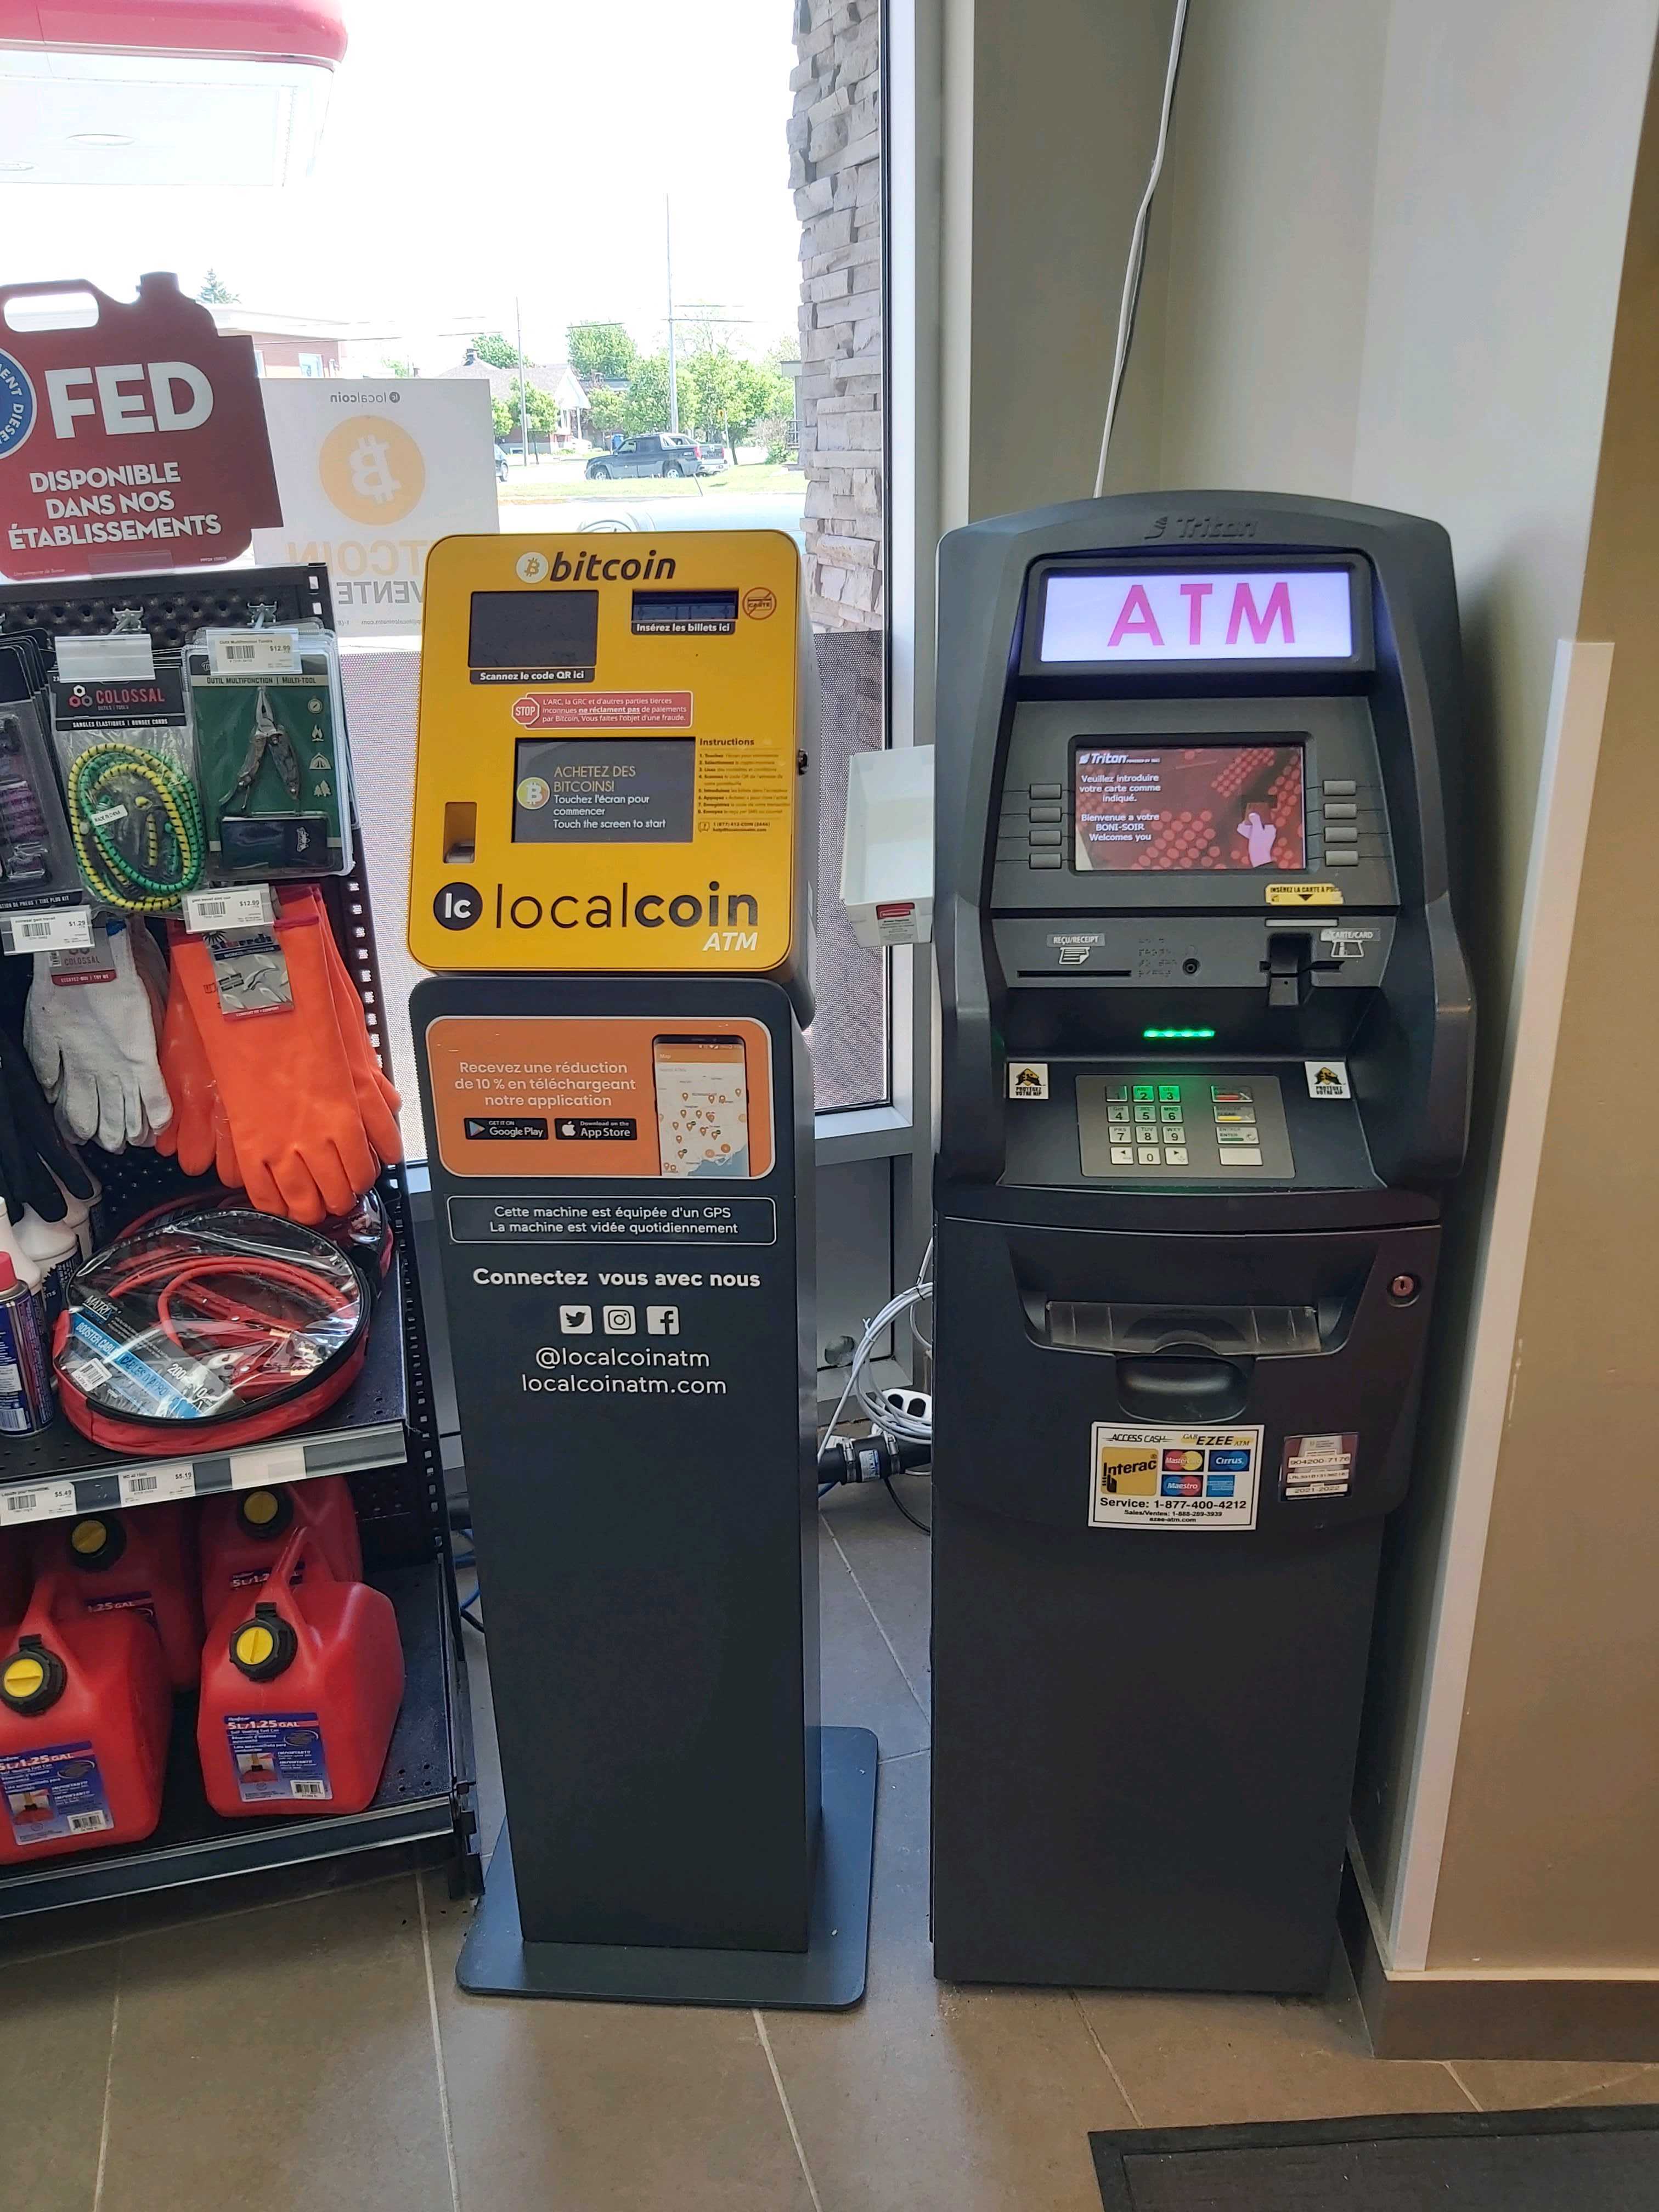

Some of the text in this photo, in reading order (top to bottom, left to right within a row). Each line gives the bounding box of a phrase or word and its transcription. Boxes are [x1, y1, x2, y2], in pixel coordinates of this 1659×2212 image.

[44, 362, 215, 439] FED
[29, 462, 181, 493] DISPONIBLE
[45, 490, 175, 520] DANS NOS
[8, 514, 222, 550] ÉTABLISSEMENTS
[550, 550, 676, 582] bitcoin
[1107, 582, 1295, 647] ATM
[636, 623, 730, 632] Insérez les billets ici
[480, 670, 584, 681] Scannez le code QR ici
[95, 687, 165, 704] COLOSSAL
[515, 706, 535, 716] STOP
[619, 715, 640, 723] l'objet
[1091, 753, 1128, 764] Triton
[554, 766, 636, 777] ACHETEZ DES
[554, 781, 615, 793] BITCOINS!
[554, 794, 650, 805] Touchez l'écran pour
[1102, 794, 1137, 803] indiqué.
[553, 808, 606, 816] commencer
[1081, 814, 1126, 822] Bienvenue
[553, 819, 666, 829] Touch the screen to start
[1089, 833, 1152, 842] Welcomes you
[496, 881, 759, 929] localcoin
[702, 932, 759, 951] ATM
[1053, 935, 1099, 945] REÇU/RECEIPT
[64, 956, 101, 966] COLOSSAL
[459, 1062, 628, 1074] Recevez une réduction
[455, 1078, 636, 1093] de 10 % en téléchargeant
[485, 1094, 612, 1109] notre application
[1139, 1092, 1148, 1101] 2
[1166, 1092, 1174, 1100] 3
[1115, 1112, 1123, 1120] 4
[1142, 1112, 1150, 1120] 5
[1168, 1112, 1176, 1120] 6
[489, 1126, 544, 1138] Google Play
[580, 1127, 631, 1139] App Store
[1117, 1132, 1125, 1141] 7
[1144, 1132, 1152, 1141] 8
[1171, 1133, 1178, 1141] 9
[1146, 1153, 1154, 1162] 0
[494, 1206, 731, 1221] Cette machine est équipée d'un GPS
[490, 1221, 738, 1235] La machine est vidée quotidiennement
[472, 1268, 761, 1287] Connectez vous avec nous
[75, 1322, 103, 1345] BOOSTER
[535, 1347, 710, 1369] @localcoinatm
[522, 1374, 727, 1395] localcoinatm.com
[1111, 1433, 1166, 1442] ACCESS CASH
[1195, 1436, 1234, 1446] EZEE
[1215, 1457, 1243, 1465] Cirrus
[1103, 1460, 1158, 1477] Interac
[1099, 1497, 1247, 1509] Service: 1-877-400-4212
